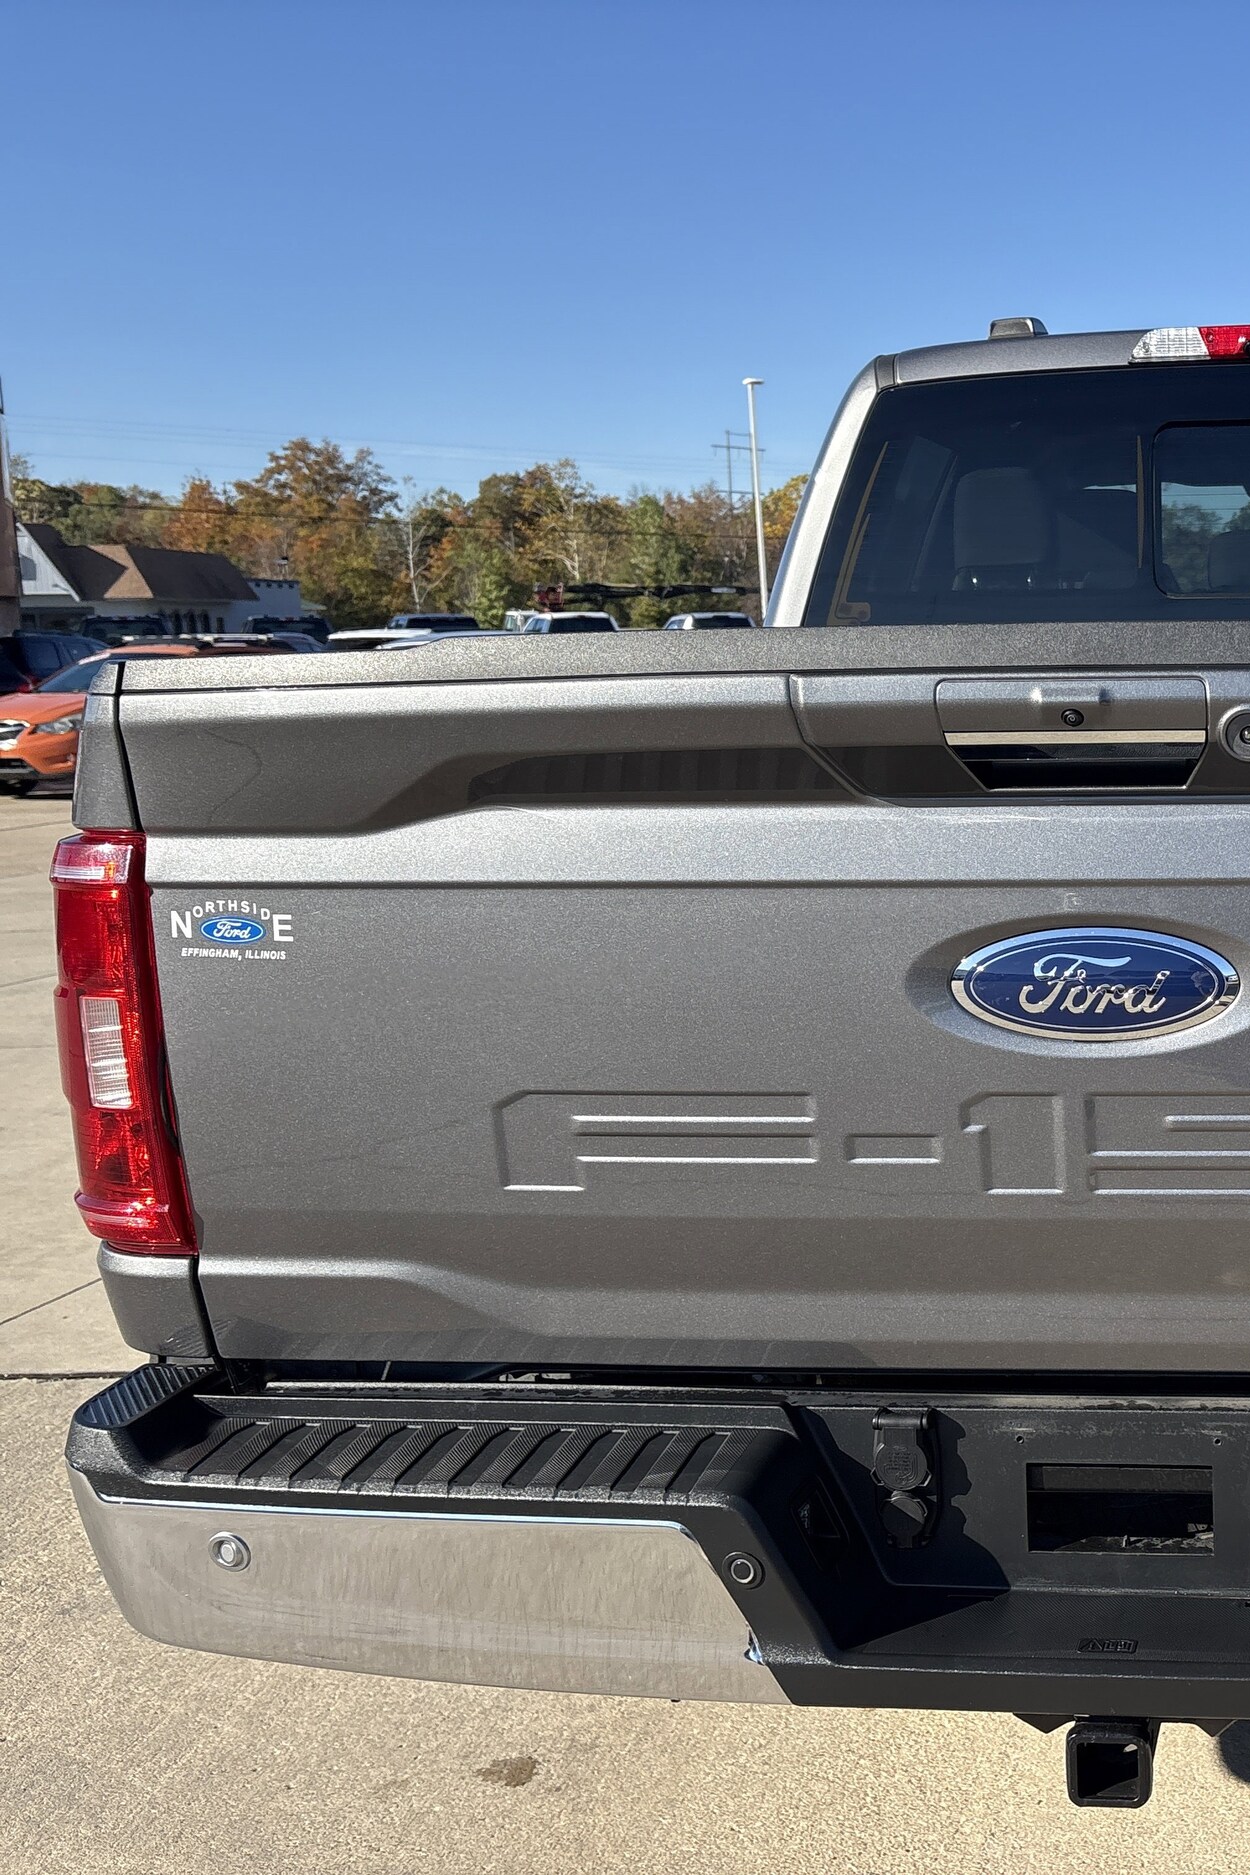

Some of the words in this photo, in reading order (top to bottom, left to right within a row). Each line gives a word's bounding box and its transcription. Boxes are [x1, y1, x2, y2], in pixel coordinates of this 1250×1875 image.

[170, 899, 294, 942] NORTHSIDE
[213, 920, 252, 939] Ford
[181, 947, 242, 961] EFFINGHAM,
[245, 949, 287, 960] ILLINOIS
[1019, 953, 1172, 1014] Ford
